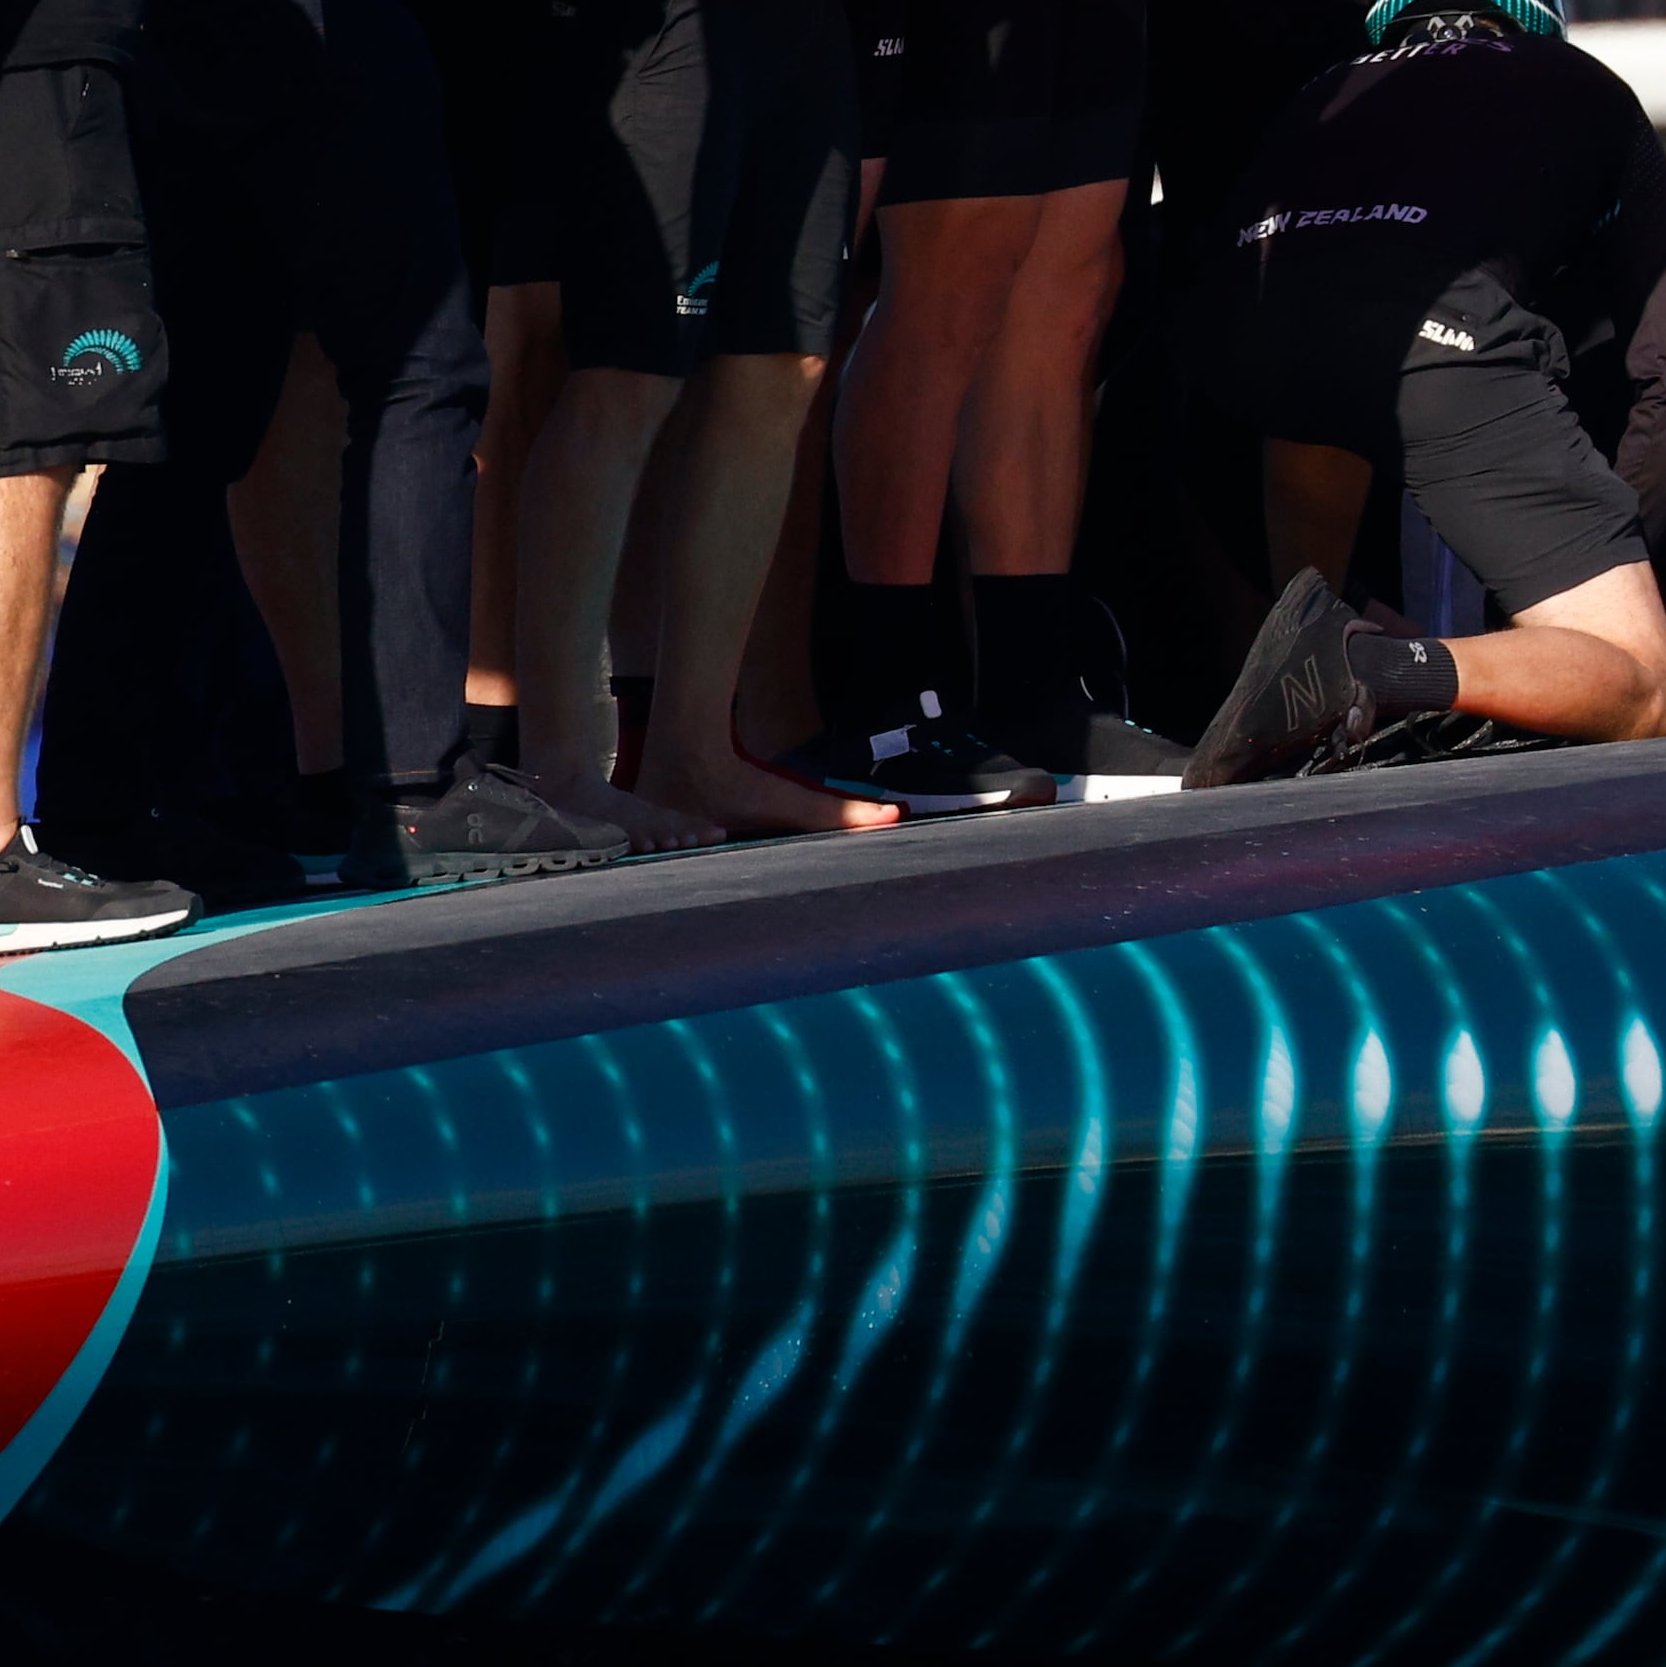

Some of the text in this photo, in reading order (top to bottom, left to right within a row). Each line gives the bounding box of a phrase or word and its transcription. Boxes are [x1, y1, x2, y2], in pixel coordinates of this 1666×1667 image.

[1237, 203, 1428, 248] NEW ZEALAND
[1418, 319, 1475, 351] SLAM
